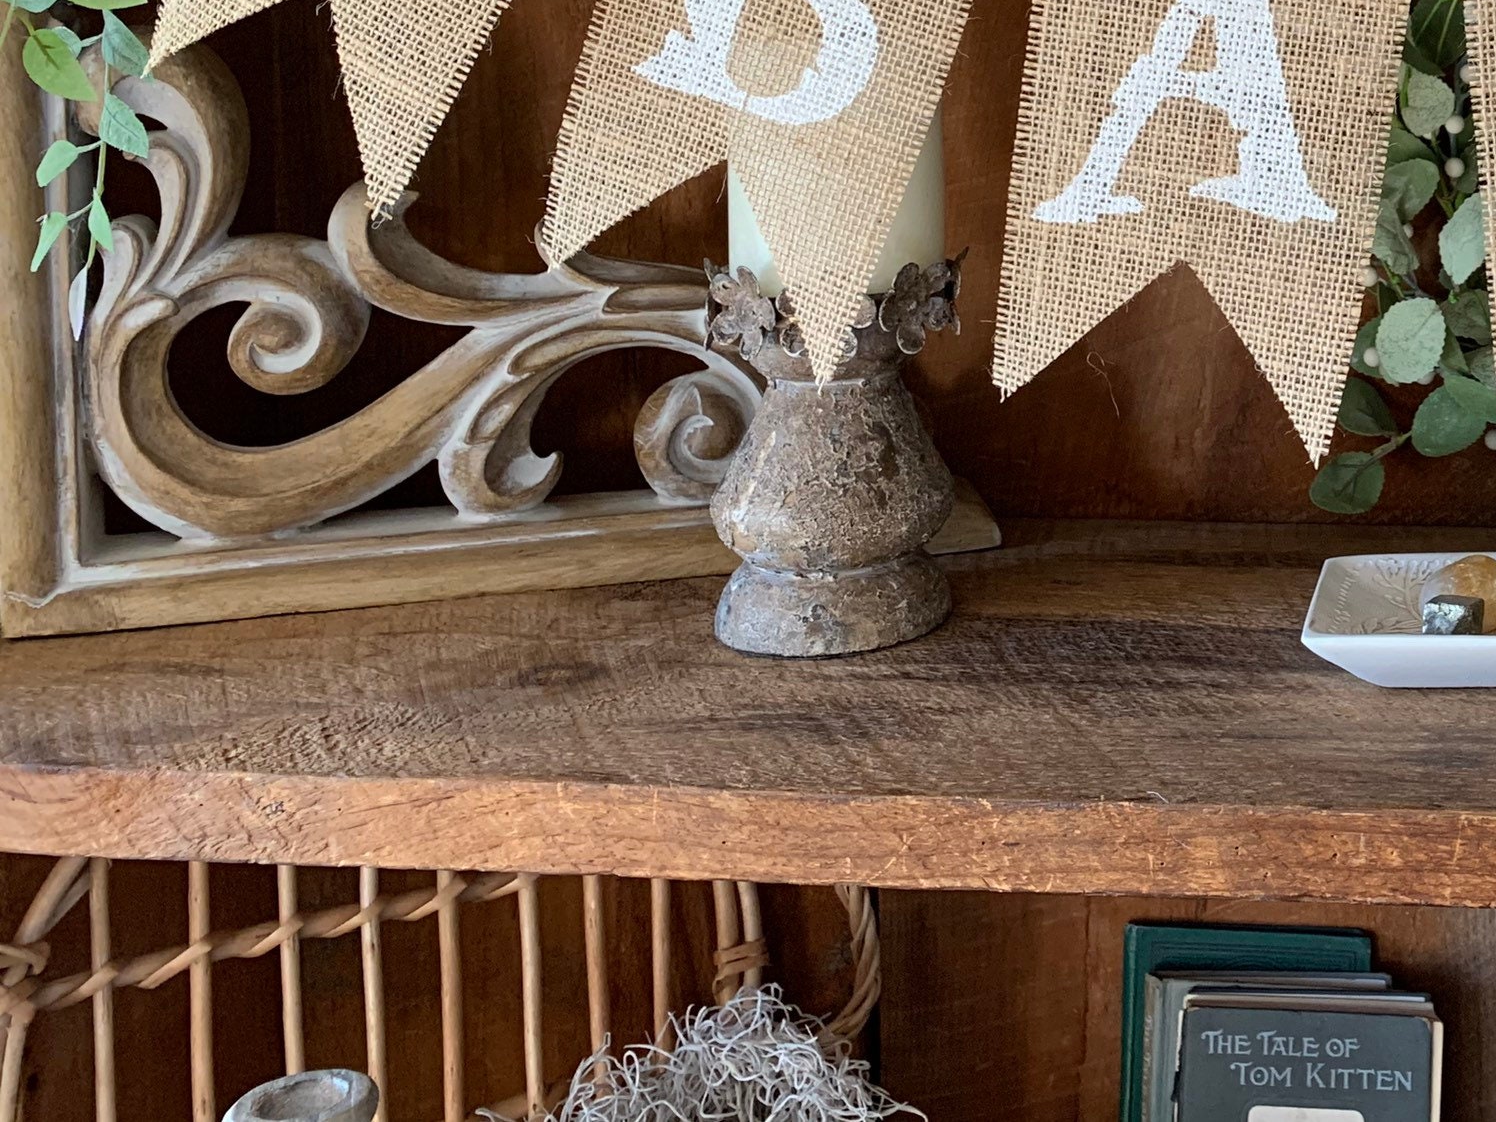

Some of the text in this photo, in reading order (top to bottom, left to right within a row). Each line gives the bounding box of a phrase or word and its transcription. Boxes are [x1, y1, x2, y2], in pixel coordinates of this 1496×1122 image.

[1201, 1029, 1360, 1060] THE TALE OF
[1230, 1062, 1413, 1092] TOM KITTEN
